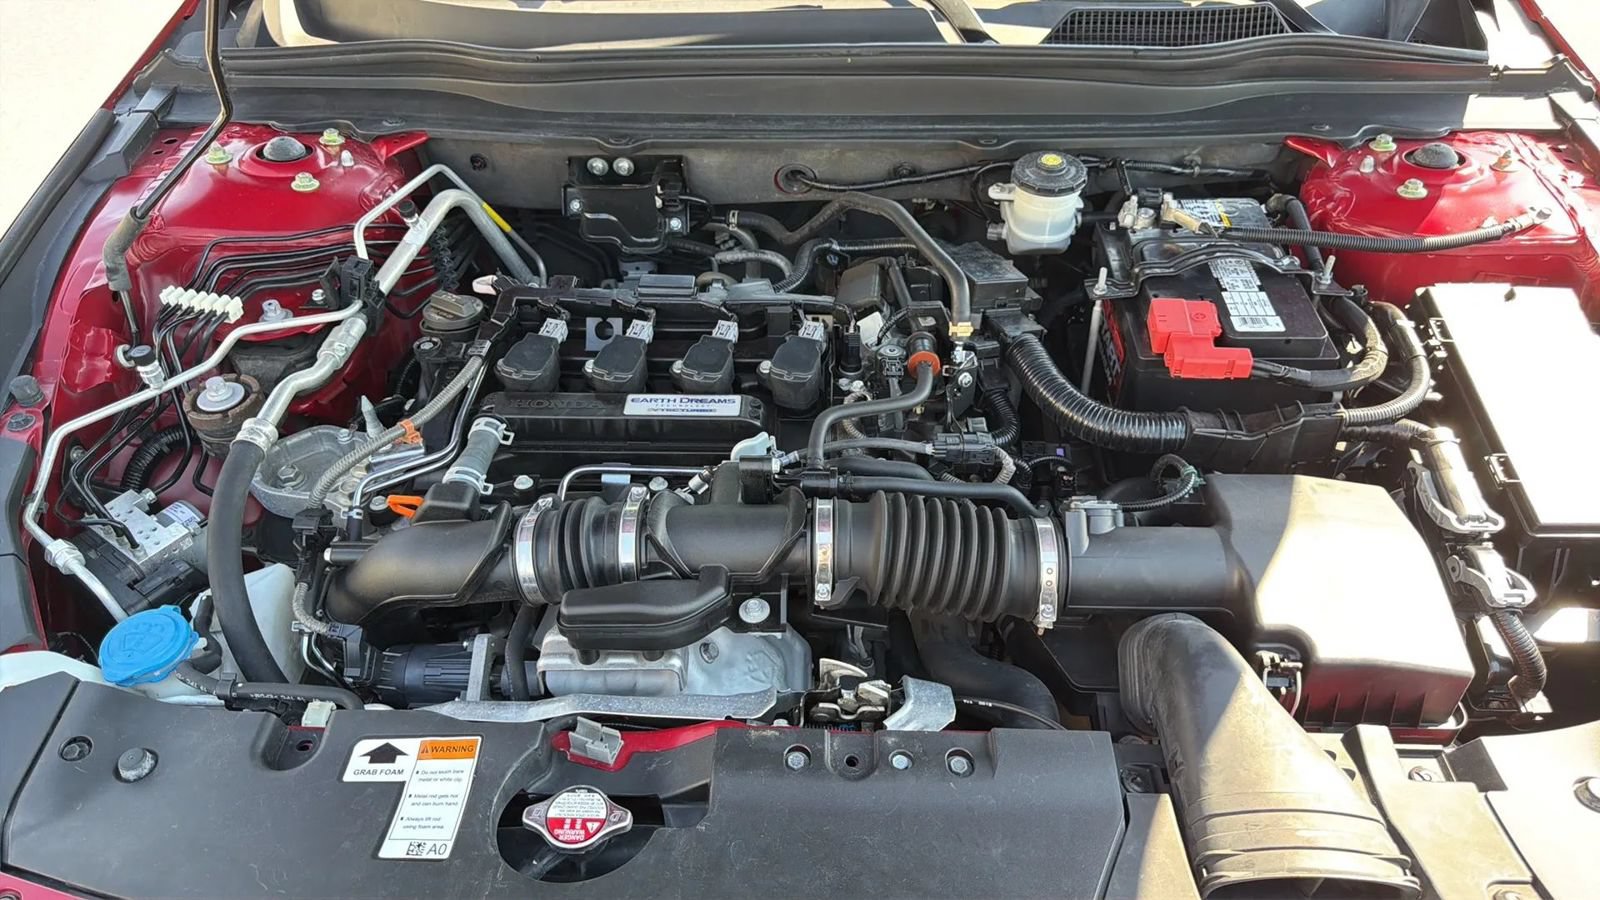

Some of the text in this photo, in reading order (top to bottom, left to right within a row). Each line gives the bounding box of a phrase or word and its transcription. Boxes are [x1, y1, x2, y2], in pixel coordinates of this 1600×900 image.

[508, 399, 607, 410] HONDA
[679, 397, 737, 405] DREAMS
[431, 745, 475, 753] WARNING
[426, 843, 448, 856] A0
